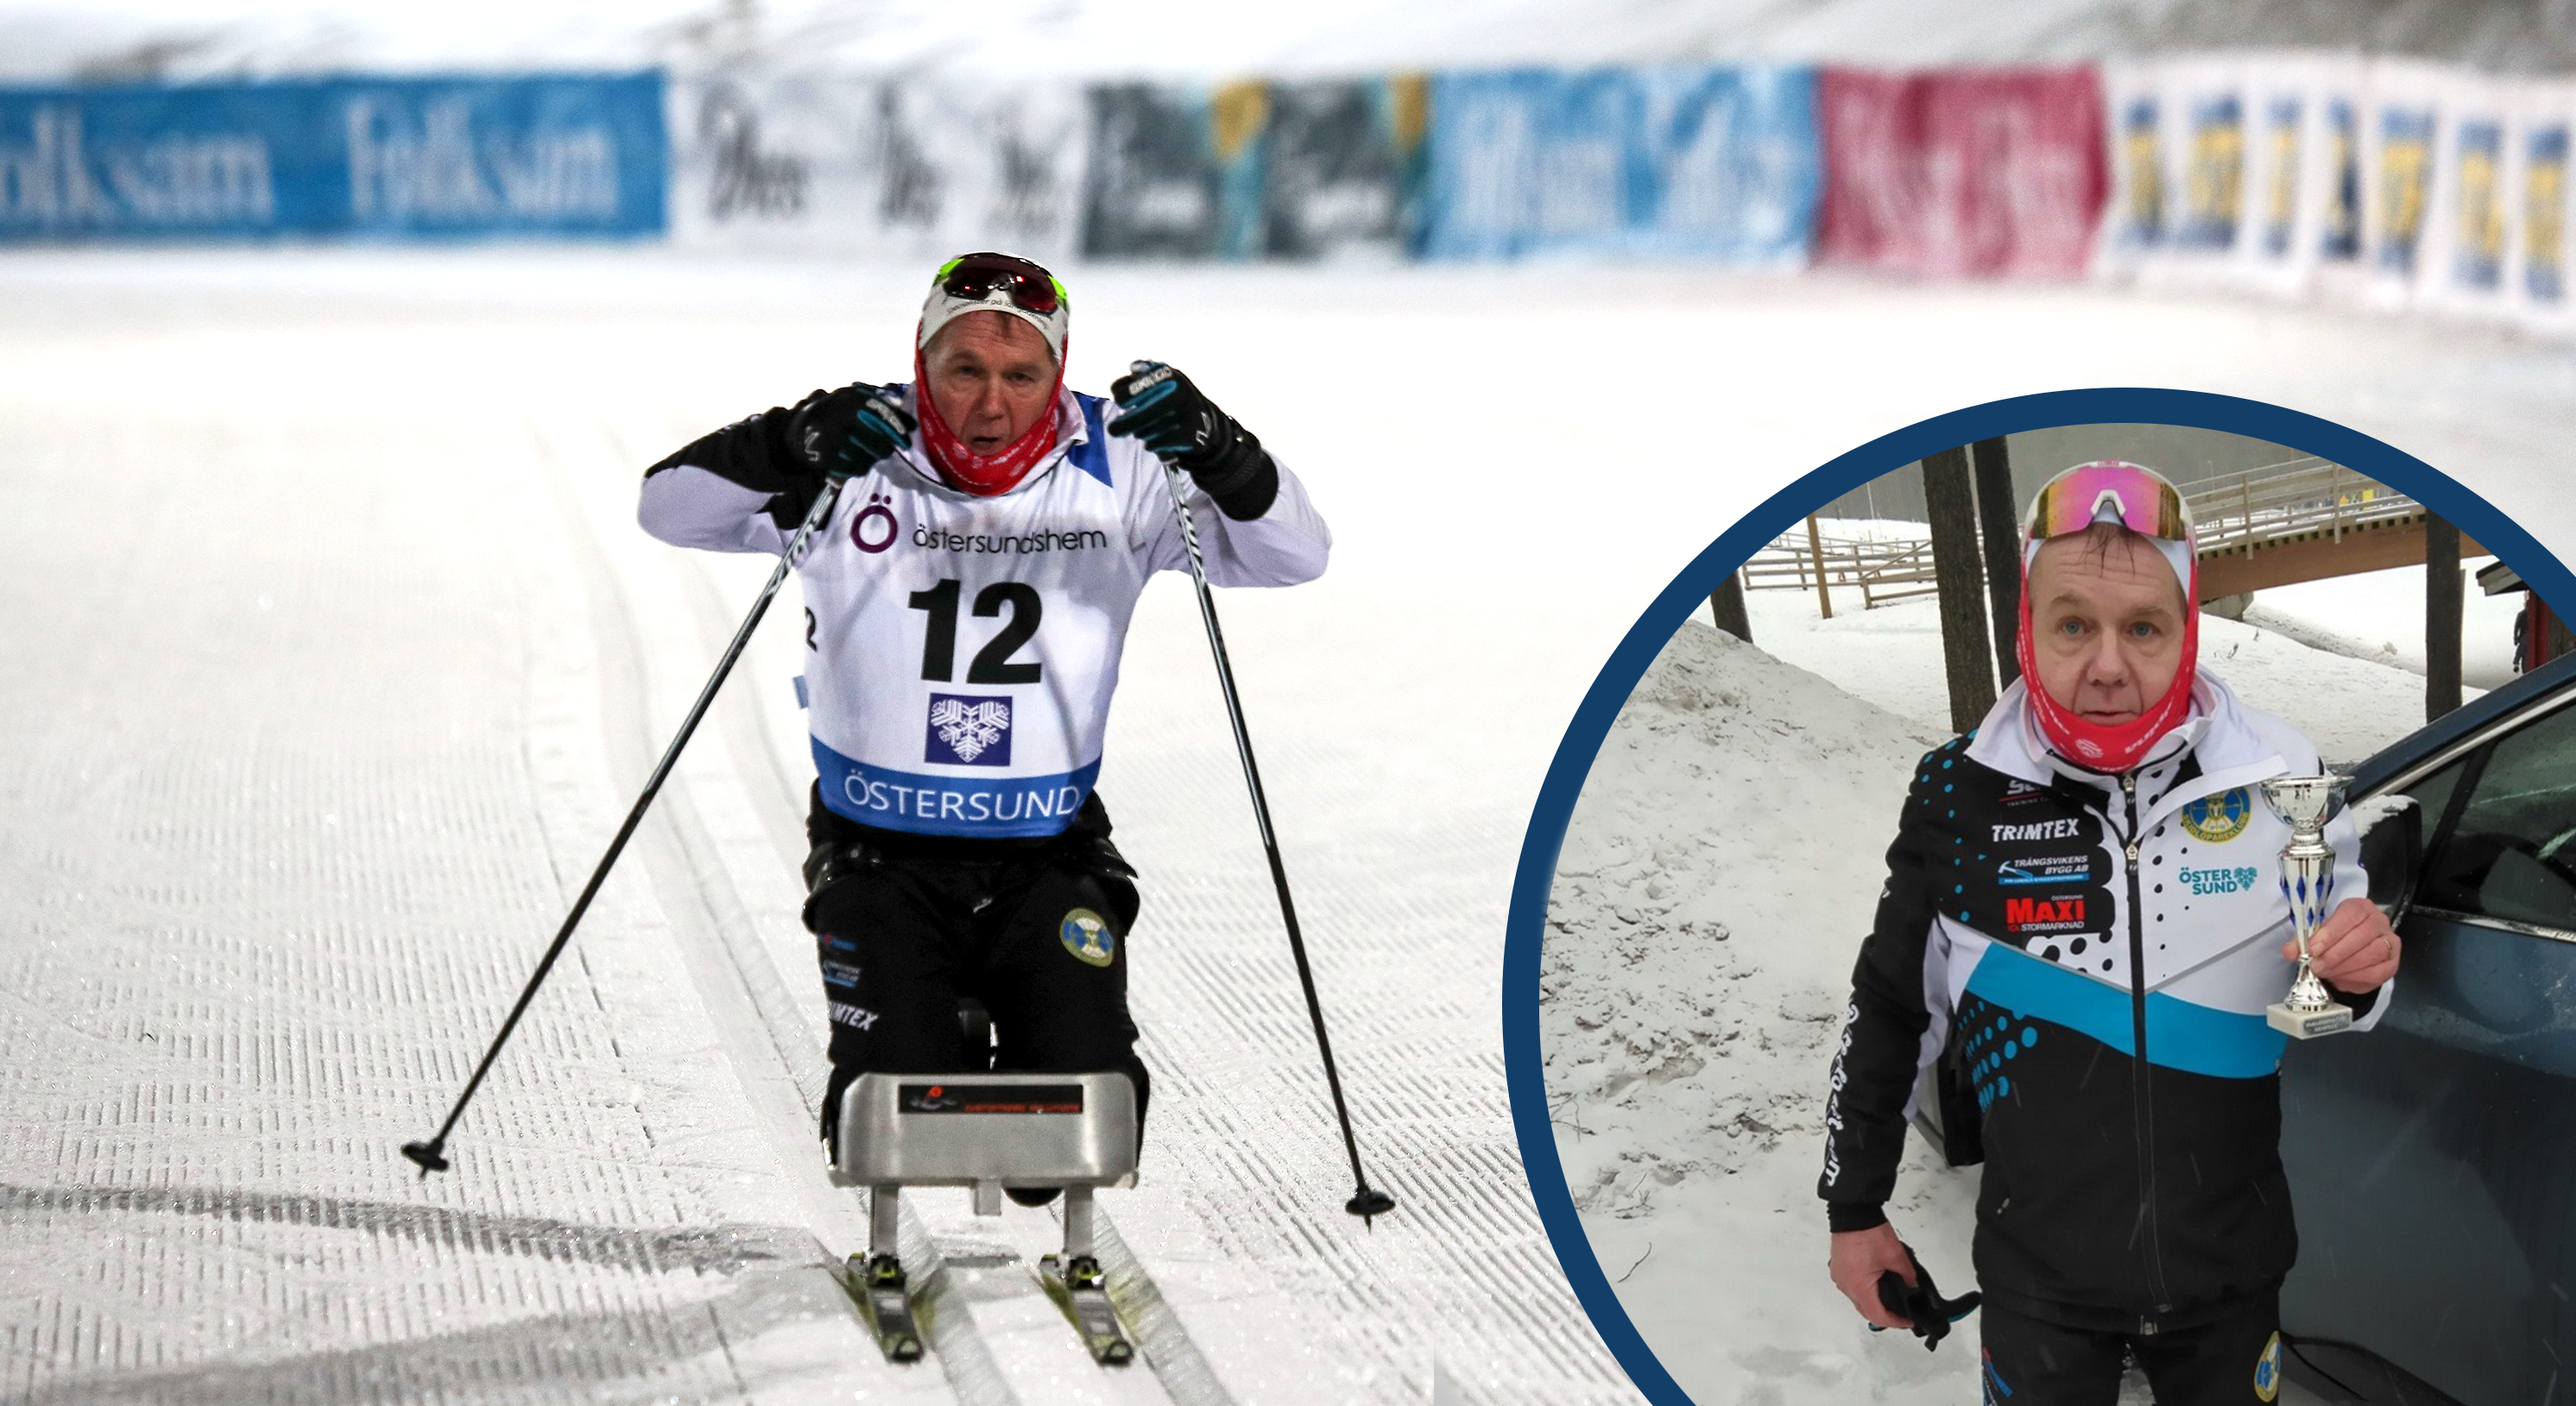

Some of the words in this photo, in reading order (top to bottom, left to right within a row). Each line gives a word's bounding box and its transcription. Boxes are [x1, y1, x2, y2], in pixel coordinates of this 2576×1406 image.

[0, 105, 275, 226] olksam
[850, 493, 898, 553] Ö
[912, 523, 1107, 555] östersundshem
[804, 606, 818, 653] 2
[908, 577, 1042, 684] 12
[843, 768, 1082, 821] ÖSTERSUND
[1992, 818, 2080, 842] TRIMTEX
[2045, 866, 2072, 875] BYGG
[2074, 864, 2089, 873] AB
[2179, 867, 2232, 884] ÖSTER
[2193, 880, 2238, 895] SUND
[2006, 897, 2086, 924] MAXI
[2021, 921, 2085, 932] STORMARKNAD
